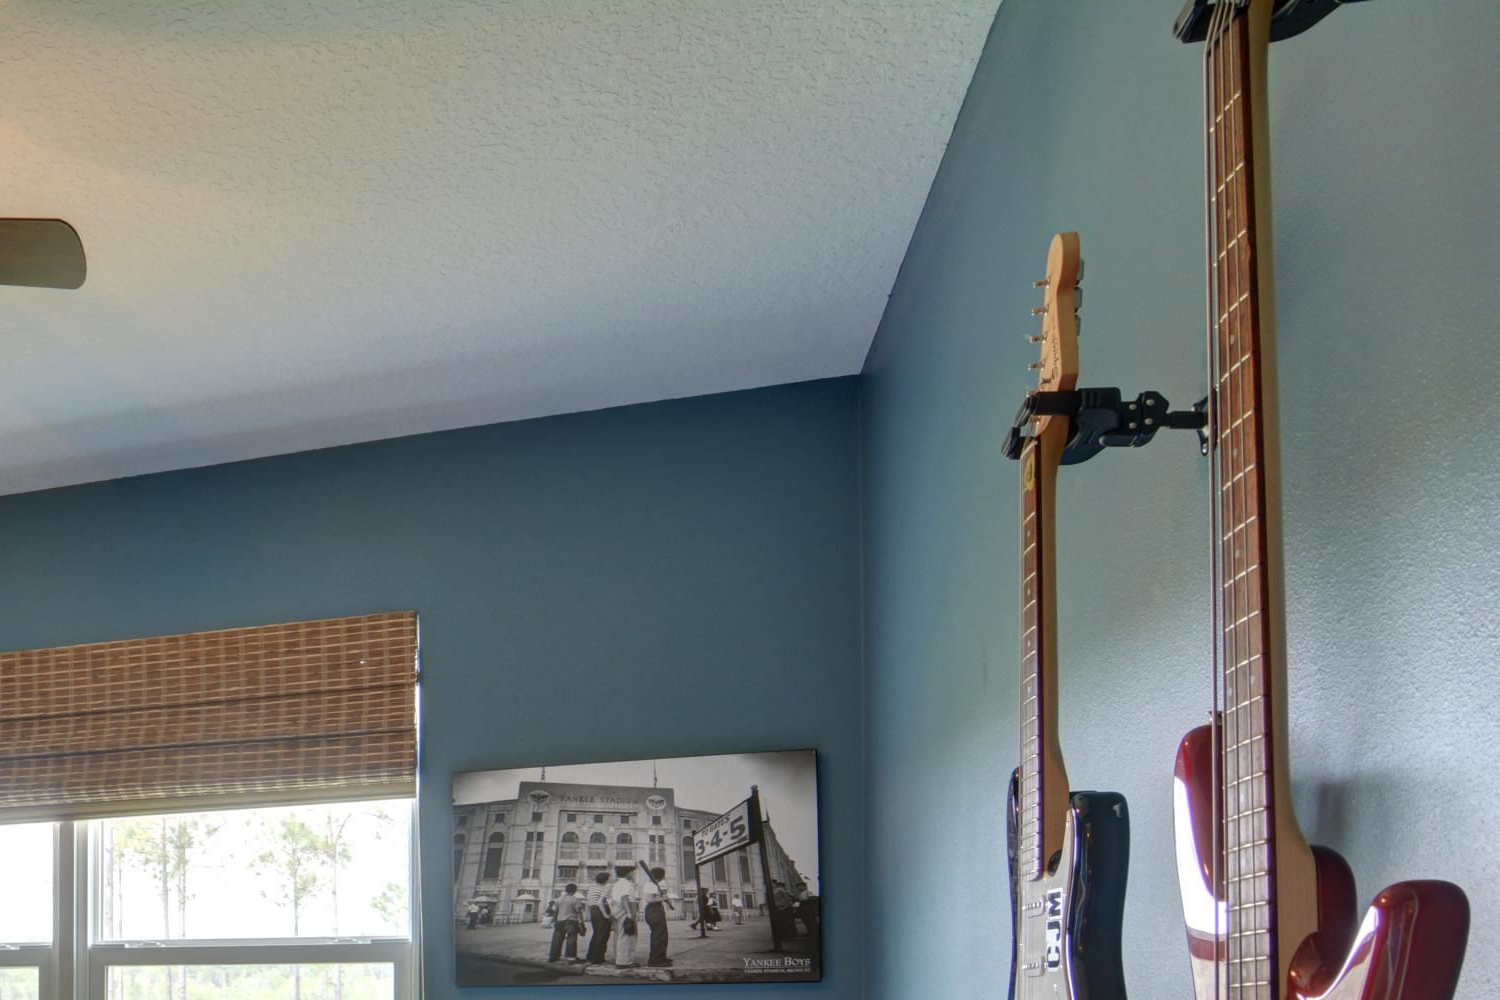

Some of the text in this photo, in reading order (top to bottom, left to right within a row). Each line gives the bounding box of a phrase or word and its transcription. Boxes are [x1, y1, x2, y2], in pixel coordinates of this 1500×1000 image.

[710, 813, 731, 832] GATES
[1046, 890, 1062, 969] CJM
[743, 956, 811, 967] YANKEE BOYS
